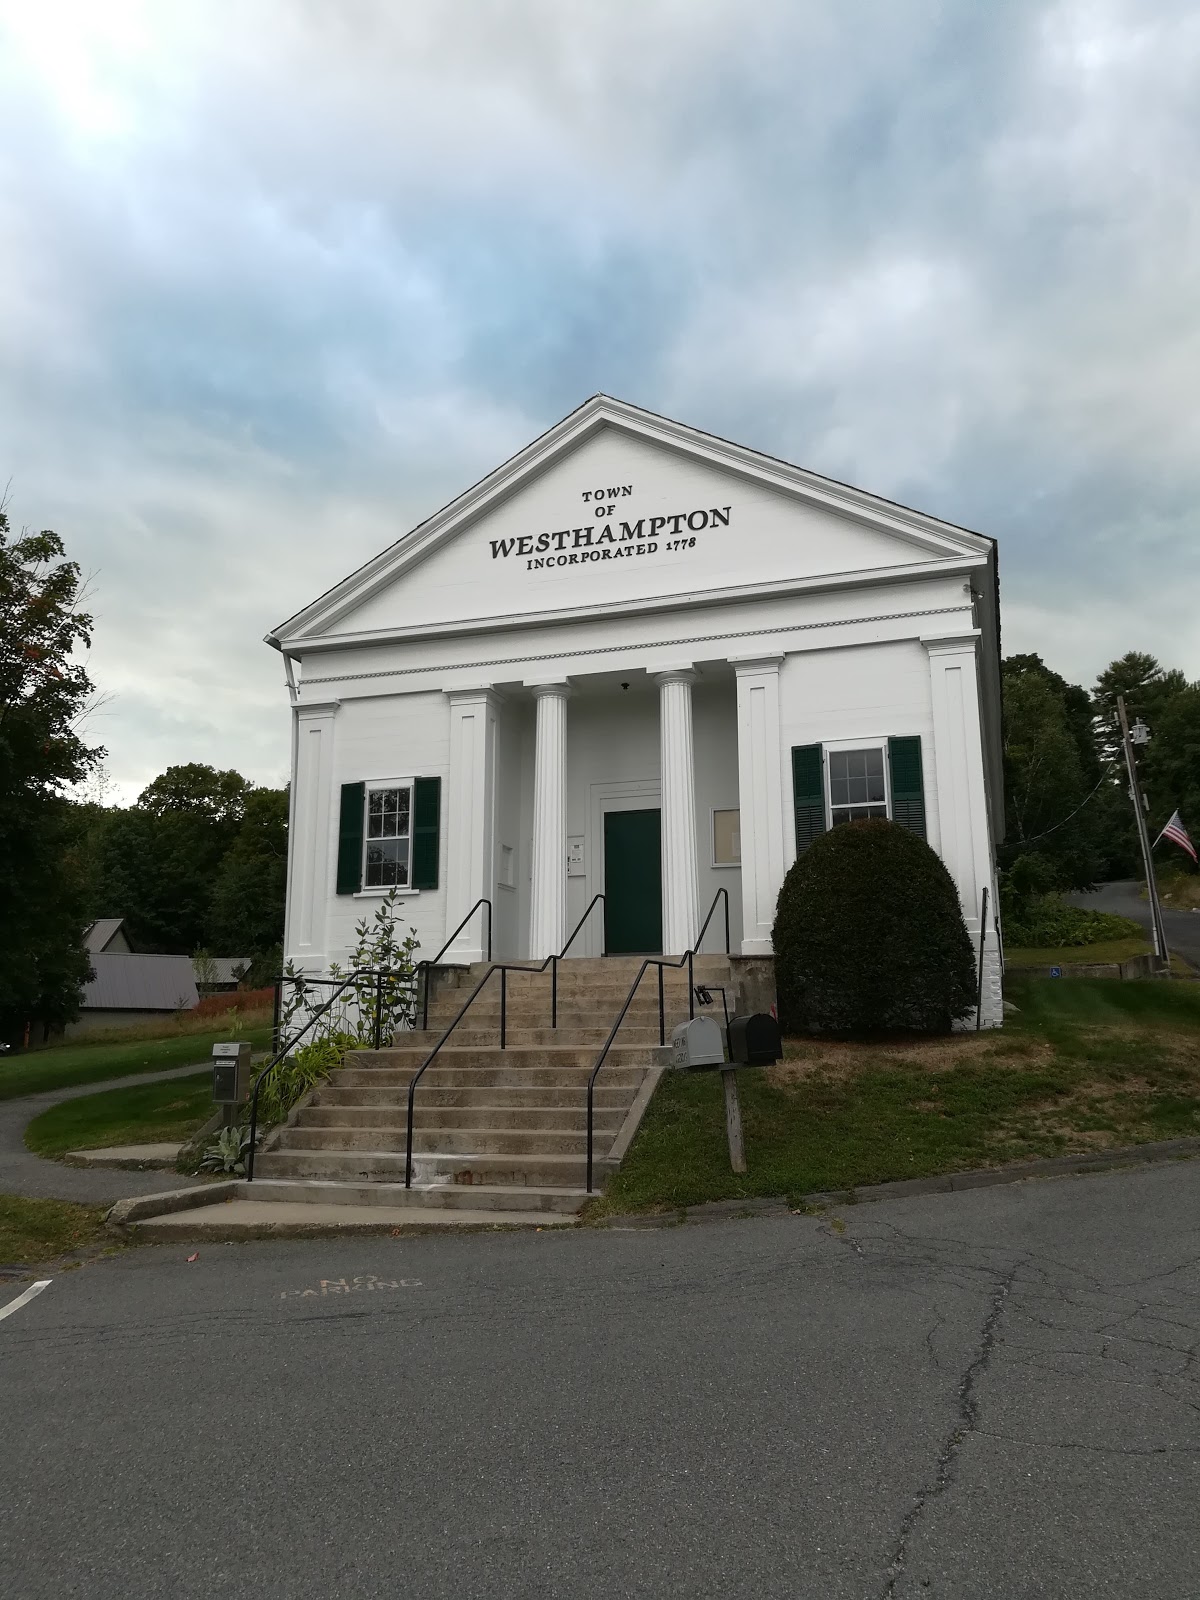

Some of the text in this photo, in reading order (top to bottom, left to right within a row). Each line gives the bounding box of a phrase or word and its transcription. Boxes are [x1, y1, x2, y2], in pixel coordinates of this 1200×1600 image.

[582, 485, 633, 502] TOWN
[594, 505, 616, 518] OF
[489, 506, 732, 559] WESTHAMPTON
[526, 537, 697, 571] INCORPORATED 1778
